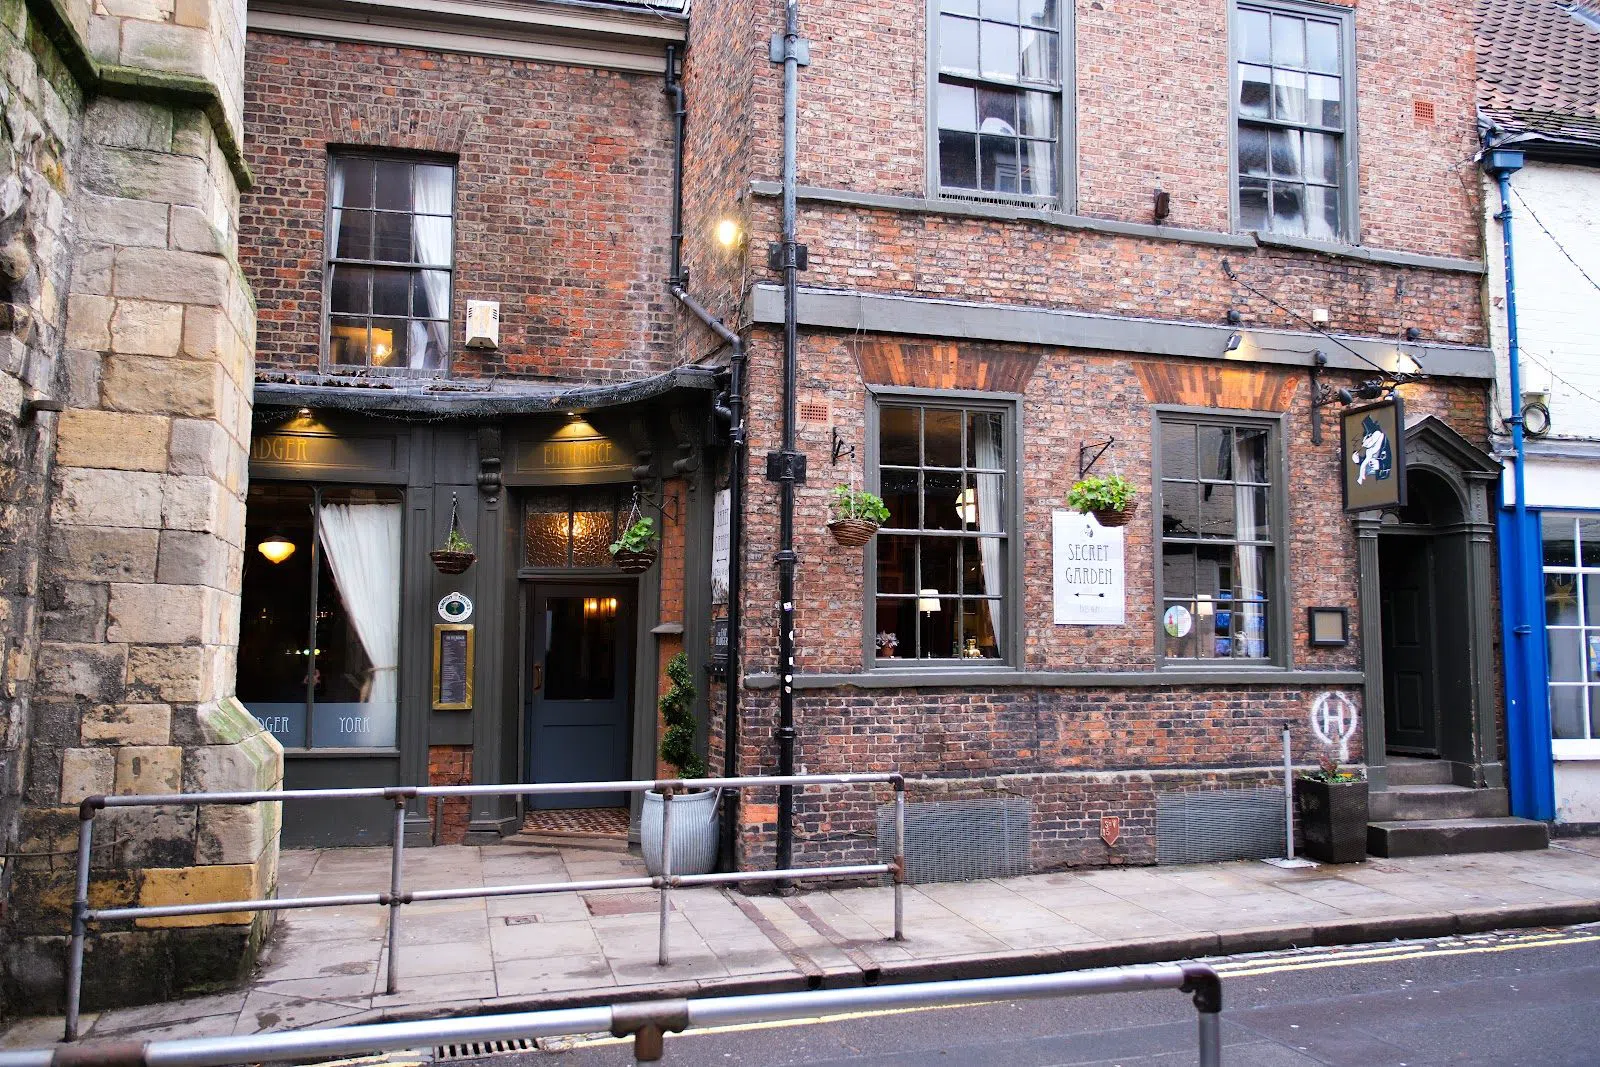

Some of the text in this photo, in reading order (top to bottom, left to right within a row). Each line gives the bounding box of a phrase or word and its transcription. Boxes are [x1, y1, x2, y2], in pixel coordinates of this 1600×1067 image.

[1067, 543, 1109, 561] SECRET
[1065, 567, 1112, 585] GARDEN
[338, 716, 370, 733] YORK
